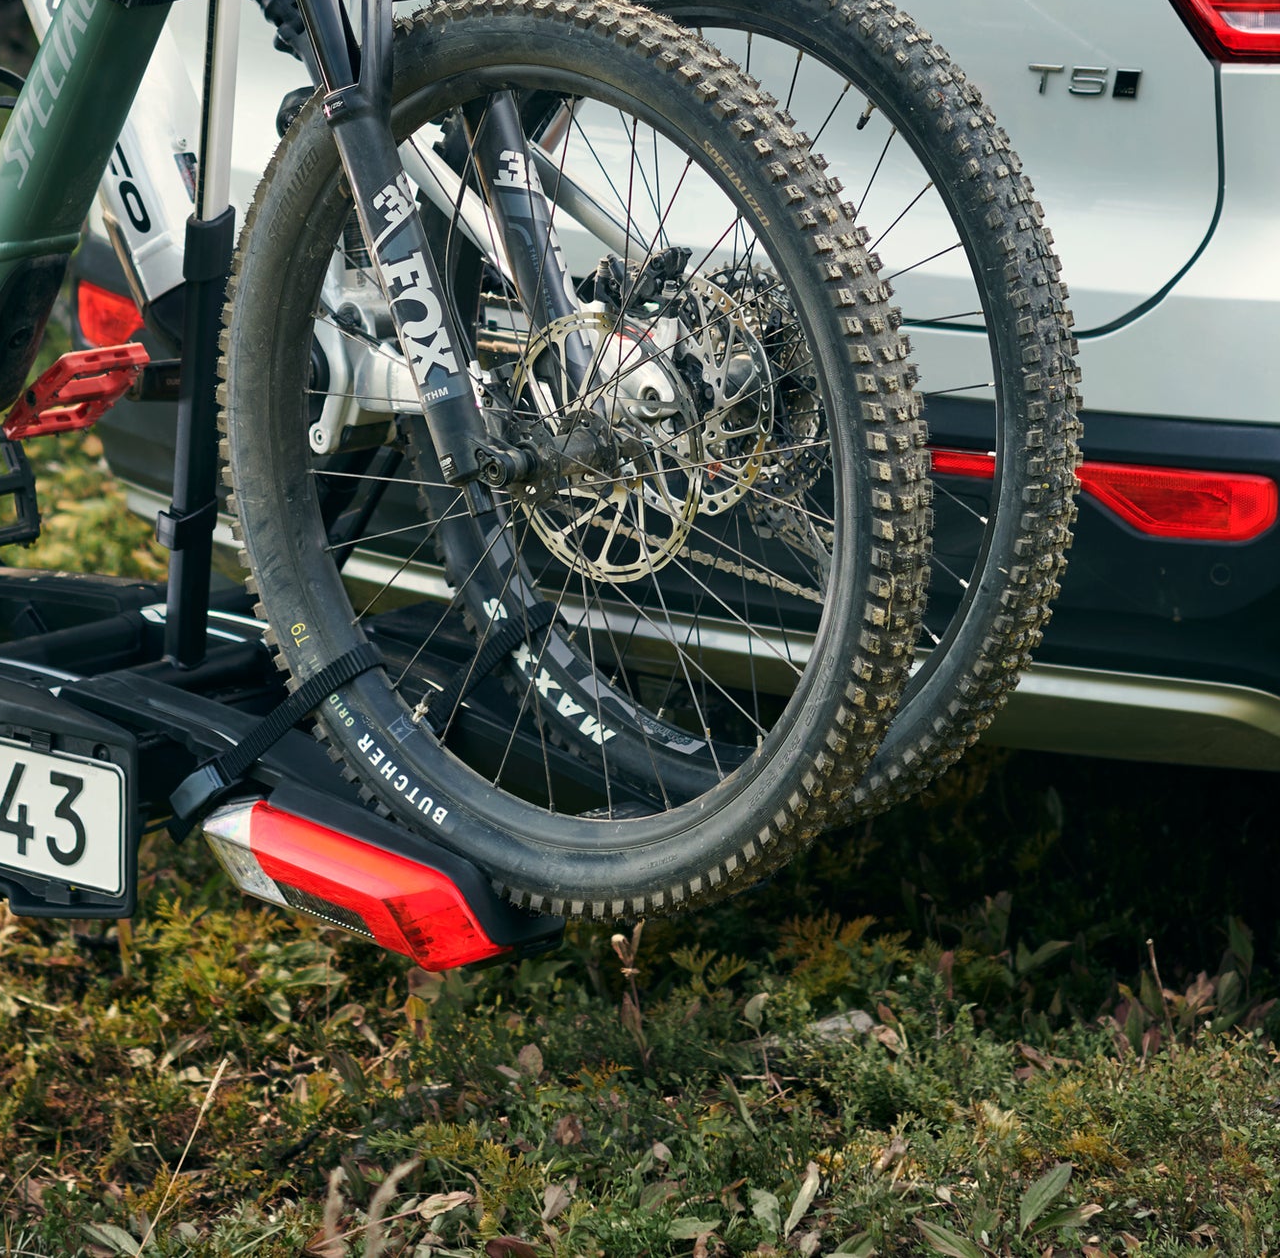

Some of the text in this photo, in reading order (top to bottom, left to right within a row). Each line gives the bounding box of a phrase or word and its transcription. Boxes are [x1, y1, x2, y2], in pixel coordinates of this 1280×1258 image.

[1028, 63, 1108, 94] T5
[703, 140, 770, 227] SPECIALIZED
[381, 251, 460, 385] FOX
[329, 694, 355, 727] GRID
[483, 597, 617, 745] MAXXS
[357, 733, 448, 825] BUTCHER
